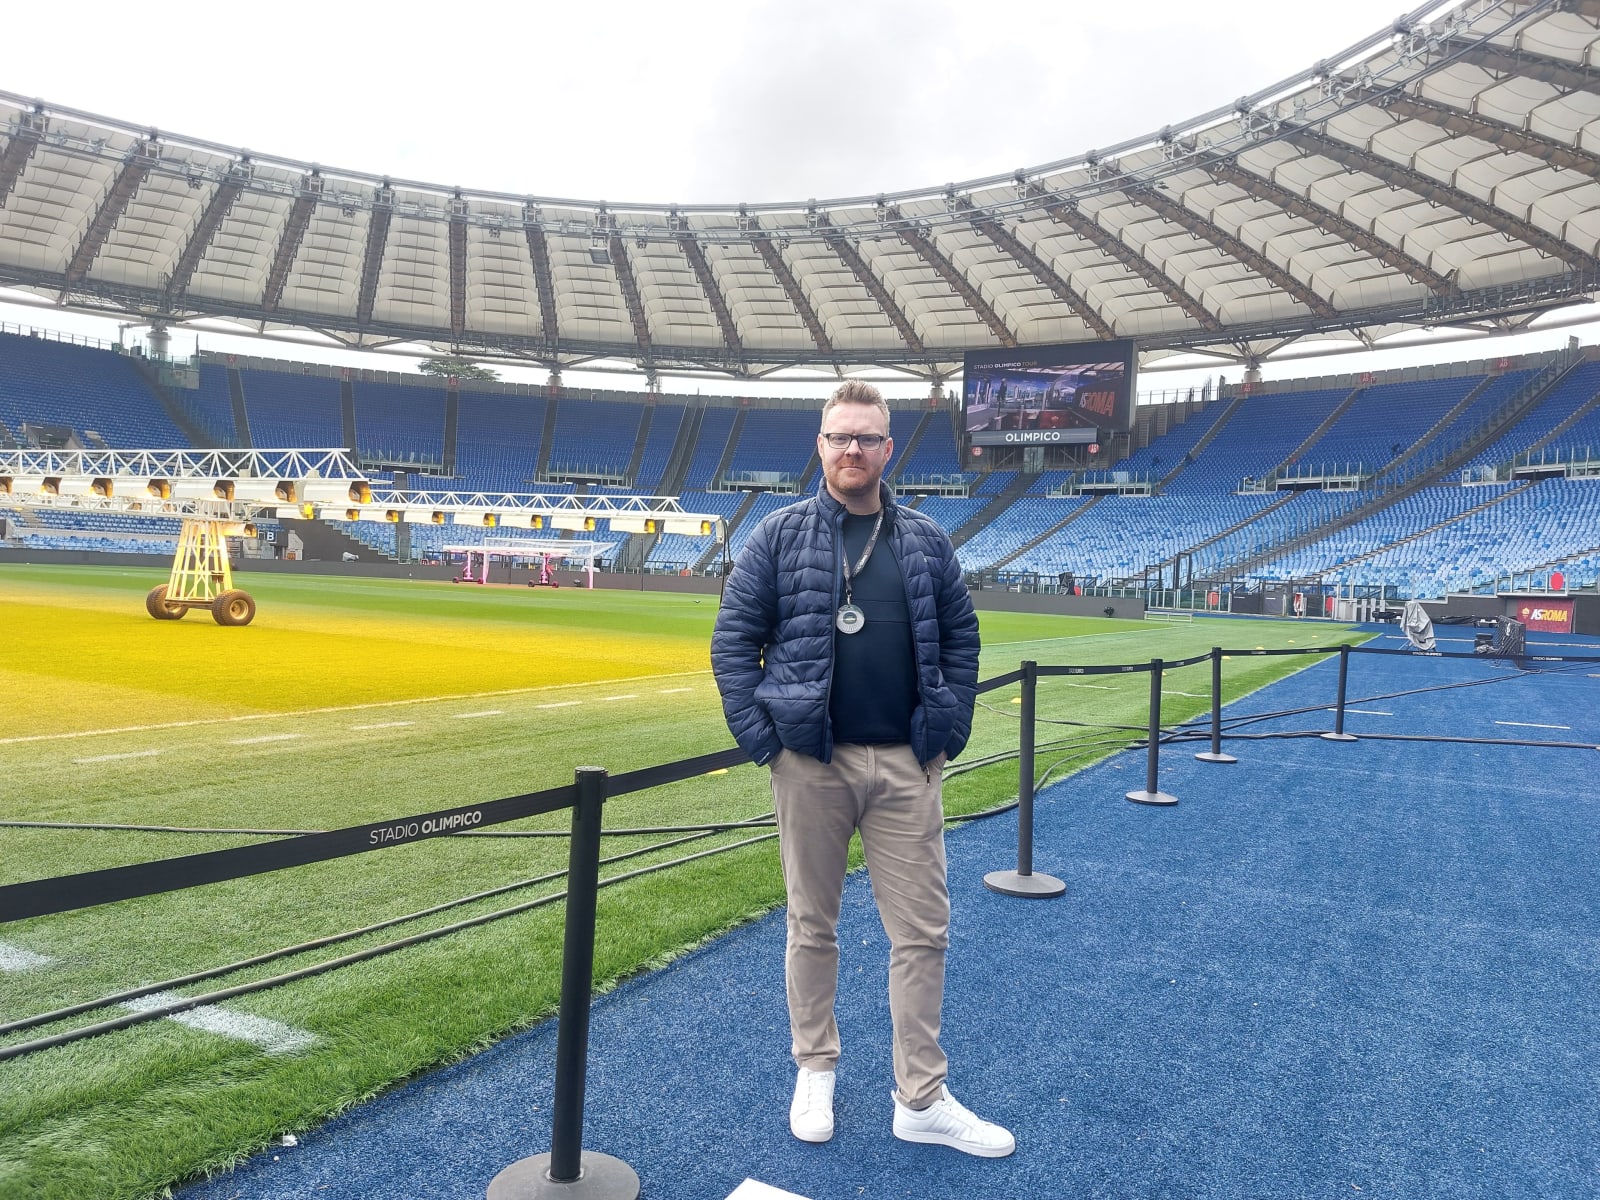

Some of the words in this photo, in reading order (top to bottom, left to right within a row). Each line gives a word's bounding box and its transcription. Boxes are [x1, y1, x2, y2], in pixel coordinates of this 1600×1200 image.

[1005, 432, 1060, 442] OLIMPICO
[267, 532, 274, 540] B
[370, 823, 418, 844] STADIO
[422, 811, 481, 833] OLIMPICO
